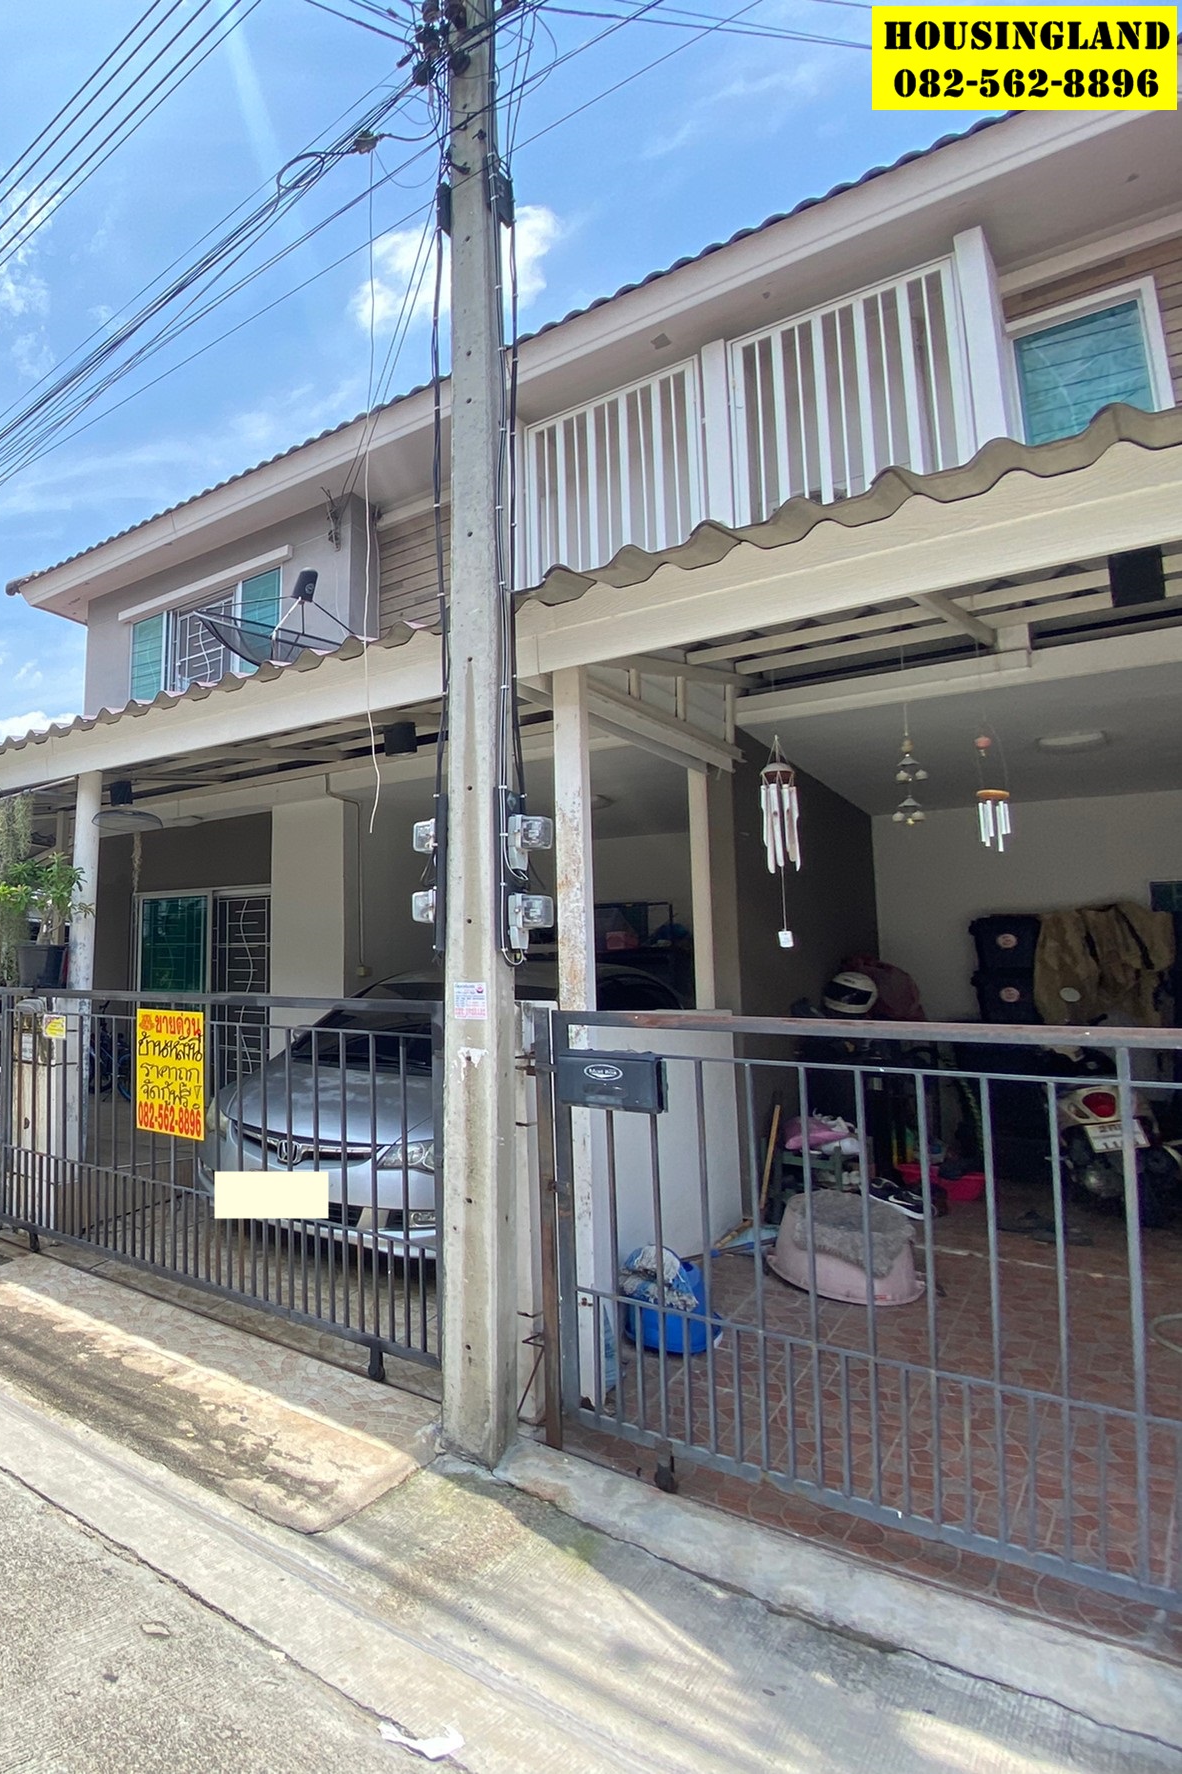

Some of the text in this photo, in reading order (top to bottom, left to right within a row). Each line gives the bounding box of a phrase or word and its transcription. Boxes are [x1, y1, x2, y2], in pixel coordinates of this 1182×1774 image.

[155, 1013, 202, 1036] ขายด่วน
[138, 1031, 203, 1062] บ้านหลังนี้
[137, 1101, 202, 1137] 082-562-8896
